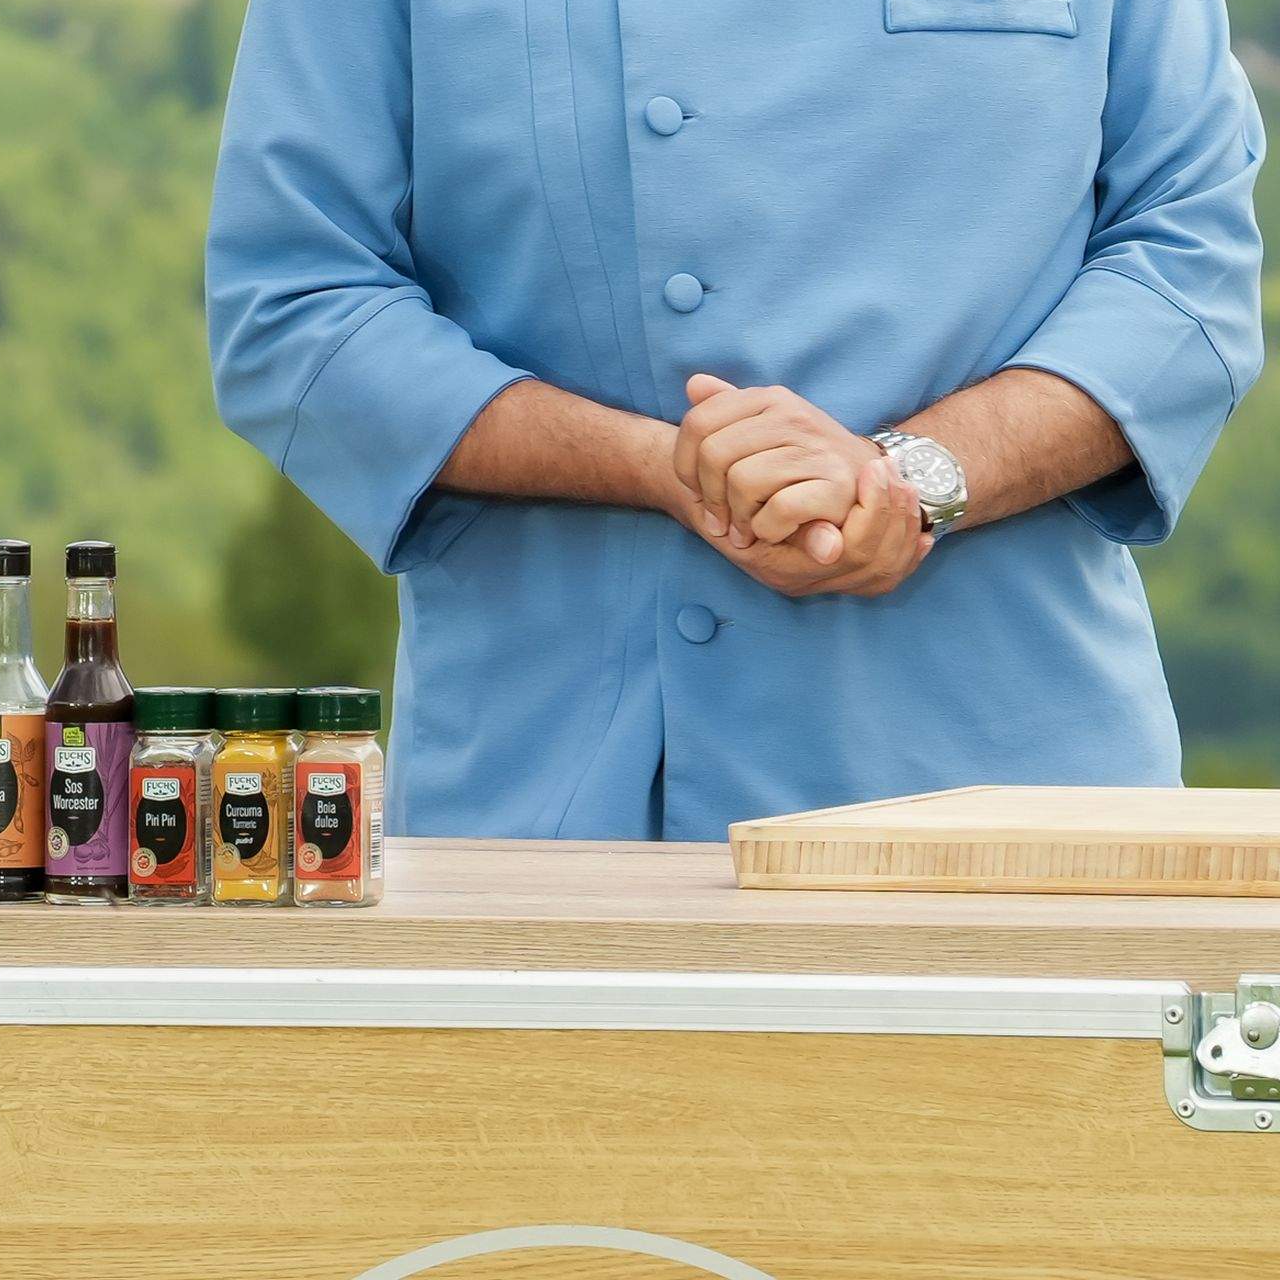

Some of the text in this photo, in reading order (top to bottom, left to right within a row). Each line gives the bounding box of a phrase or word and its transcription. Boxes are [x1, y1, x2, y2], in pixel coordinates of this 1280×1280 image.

[59, 750, 91, 765] FUCHS
[64, 778, 83, 794] Sos
[146, 781, 176, 794] FUCHS
[229, 776, 258, 789] FUCHS
[312, 776, 342, 789] FUCHS
[53, 794, 99, 810] Worcester
[317, 800, 337, 814] Boia
[225, 803, 263, 818] Curcuma
[145, 812, 177, 827] Piri Piri
[314, 815, 339, 829] dulce
